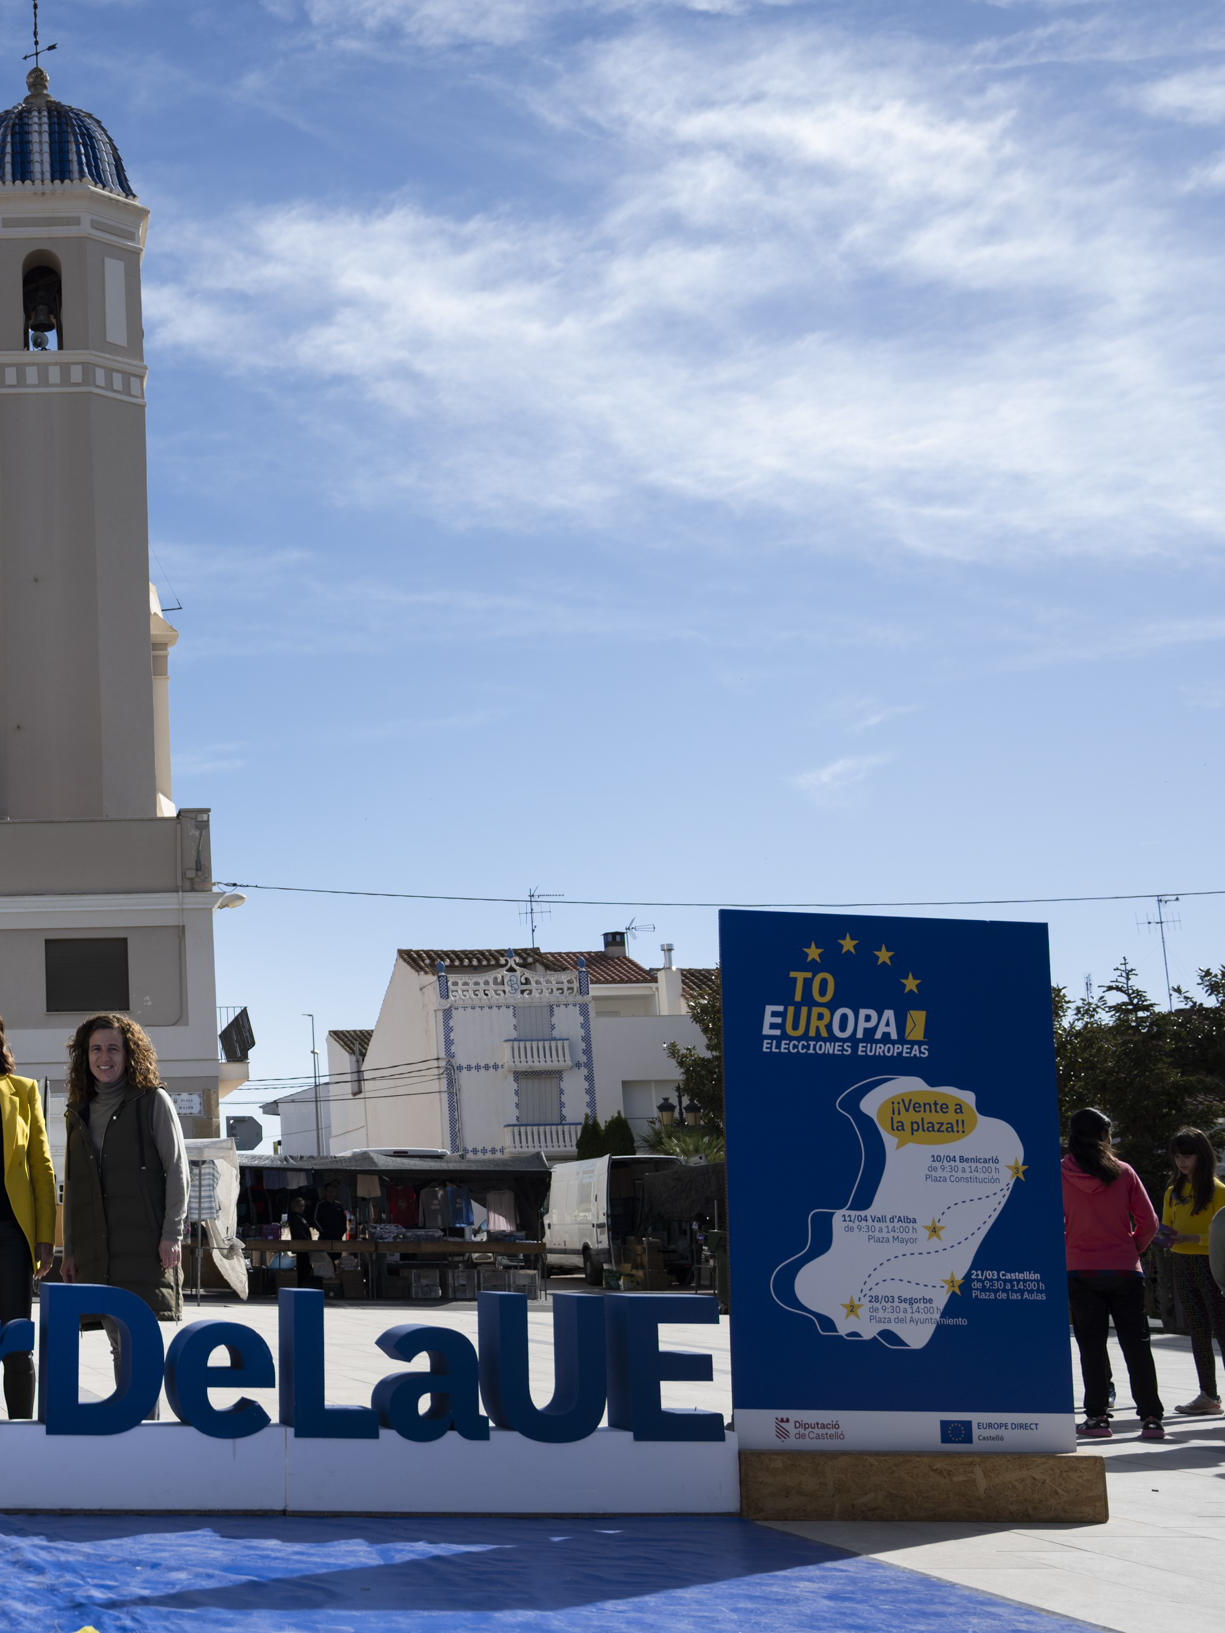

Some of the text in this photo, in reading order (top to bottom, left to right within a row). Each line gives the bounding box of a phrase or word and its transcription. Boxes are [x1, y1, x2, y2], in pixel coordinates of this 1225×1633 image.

[789, 971, 835, 1003] TO
[762, 1005, 898, 1040] EUROPA
[762, 1040, 929, 1057] ELECCIONES EUROPEAS
[891, 1098, 964, 1116] ¡¡Vente a
[890, 1116, 965, 1135] la plaza!!
[930, 1155, 999, 1165] 10/04 Benicarló
[928, 1164, 938, 1172] de
[940, 1165, 959, 1173] 9:30
[968, 1165, 993, 1174] 14:00
[995, 1166, 1000, 1174] h
[1014, 1166, 1019, 1175] 3
[925, 1174, 1000, 1184] Plaza Constitución
[842, 1214, 917, 1224] 11/04 Vall d'Alba
[844, 1224, 854, 1232] de
[857, 1225, 876, 1233] 9:30
[885, 1225, 910, 1234] 14:00
[912, 1226, 917, 1234] h
[931, 1226, 937, 1234] 4
[868, 1235, 918, 1245] Plaza Mayor
[971, 1270, 1041, 1280] 21/03 Castellón
[950, 1280, 956, 1288] 1
[971, 1280, 1045, 1290] de 9:30 a 14:00 h
[868, 1295, 933, 1305] 28/03 Segorbe
[972, 1290, 1046, 1300] Plaza de las Aulas
[869, 1305, 879, 1313] de
[881, 1305, 901, 1314] 9:30
[910, 1306, 934, 1315] 14:00
[936, 1306, 942, 1315] h
[869, 1315, 968, 1326] Plaza del Ayuntamiento
[794, 1420, 840, 1431] Diputació
[977, 1422, 1009, 1430] EUROPE
[794, 1431, 845, 1440] de Castelló
